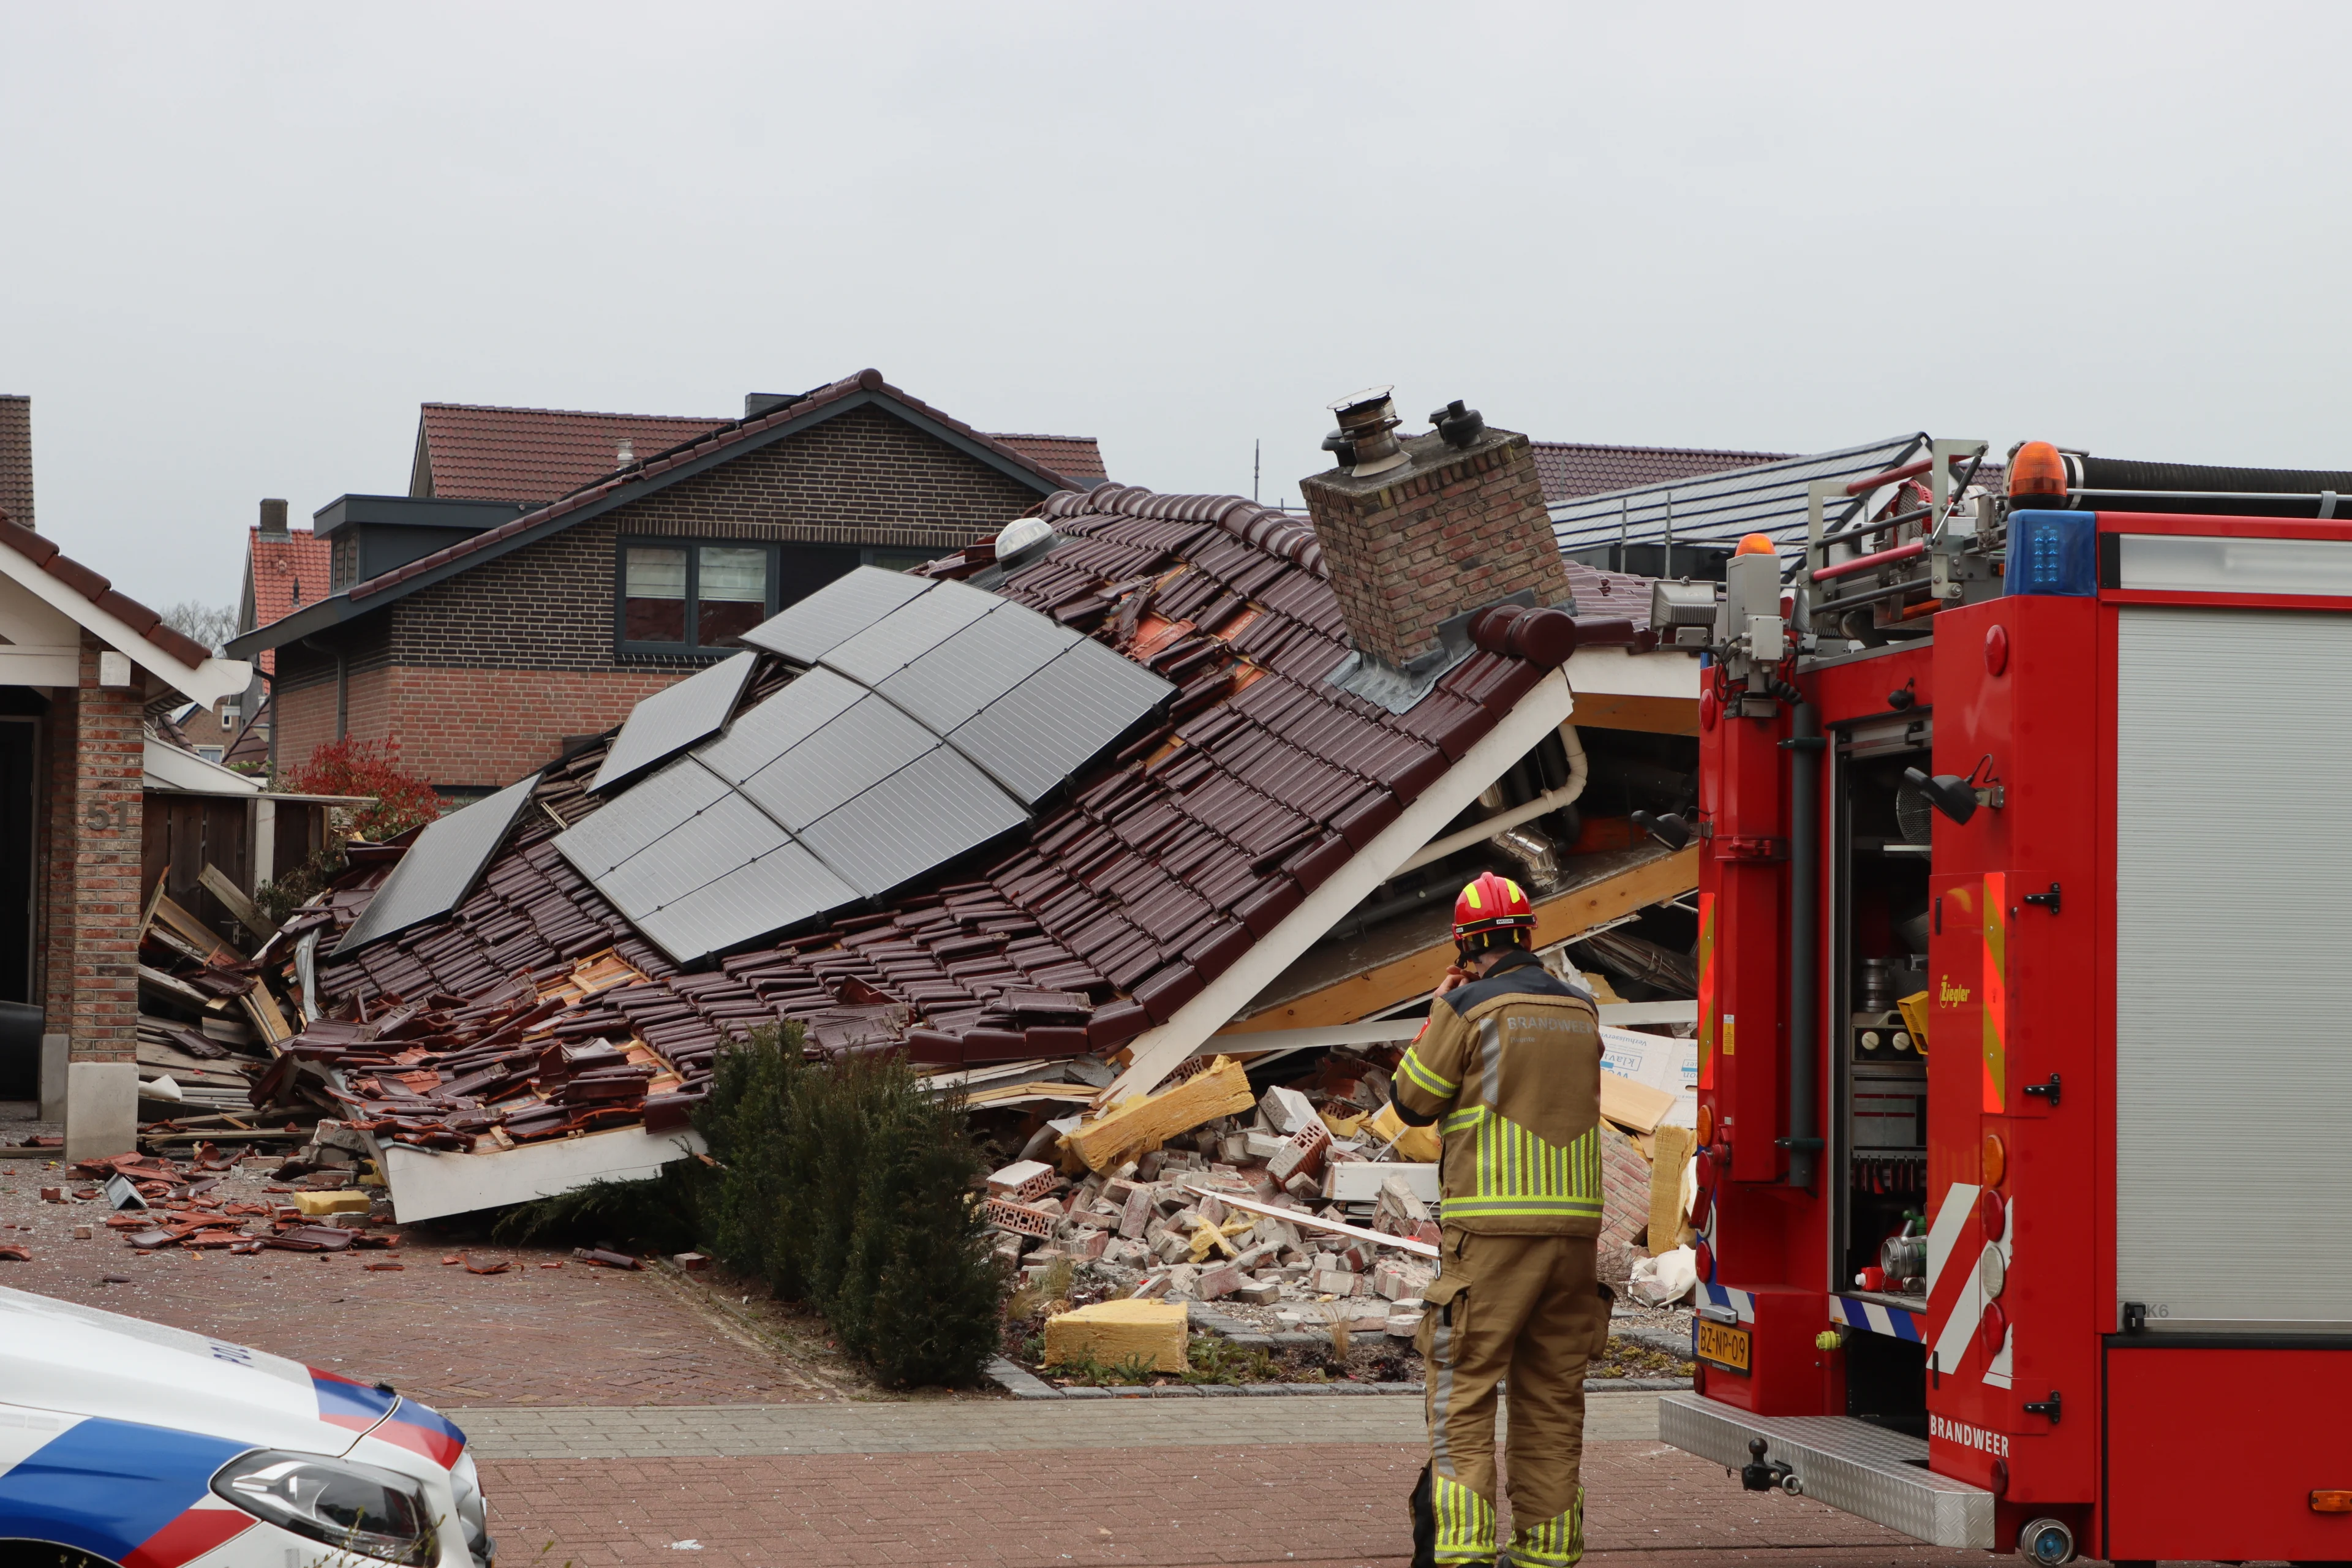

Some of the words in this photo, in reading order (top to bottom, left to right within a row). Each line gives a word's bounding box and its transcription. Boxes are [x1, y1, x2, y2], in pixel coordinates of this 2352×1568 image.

[87, 799, 127, 831] 51
[1940, 980, 1970, 1008] Ziegler
[1600, 1033, 1647, 1046] Verhuisservi
[1604, 1054, 1635, 1067] klavi
[2147, 1304, 2169, 1317] K6
[1700, 1325, 1746, 1363] BZ-NP-09
[1931, 1414, 2009, 1458] BRANDWEER
